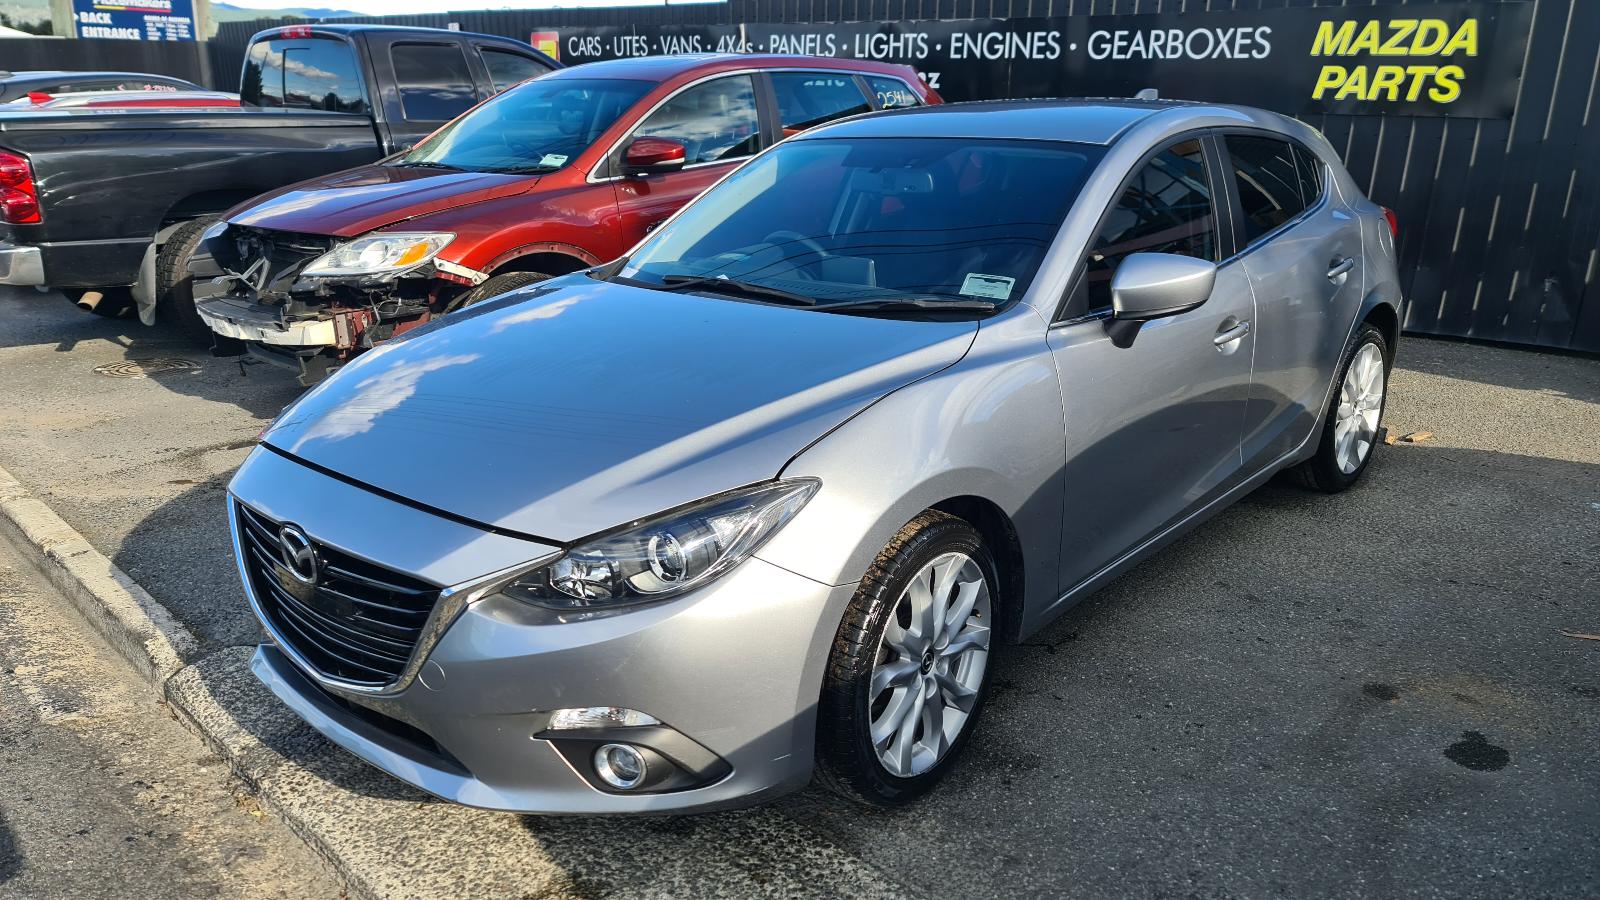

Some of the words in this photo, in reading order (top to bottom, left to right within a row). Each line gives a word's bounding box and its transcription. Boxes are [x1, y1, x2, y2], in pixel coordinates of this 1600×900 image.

[80, 11, 112, 24] BACK
[82, 26, 141, 40] ENTRANCE
[568, 36, 602, 56] CARS
[614, 35, 648, 56] UTES
[660, 35, 701, 54] VANS
[769, 33, 836, 57] PANELS
[855, 33, 929, 59] LIGHTS
[950, 31, 1061, 59] ENGINES
[1087, 26, 1272, 60] GEARBOXES
[1310, 18, 1478, 57] MAZDA
[1311, 65, 1466, 104] PARTS
